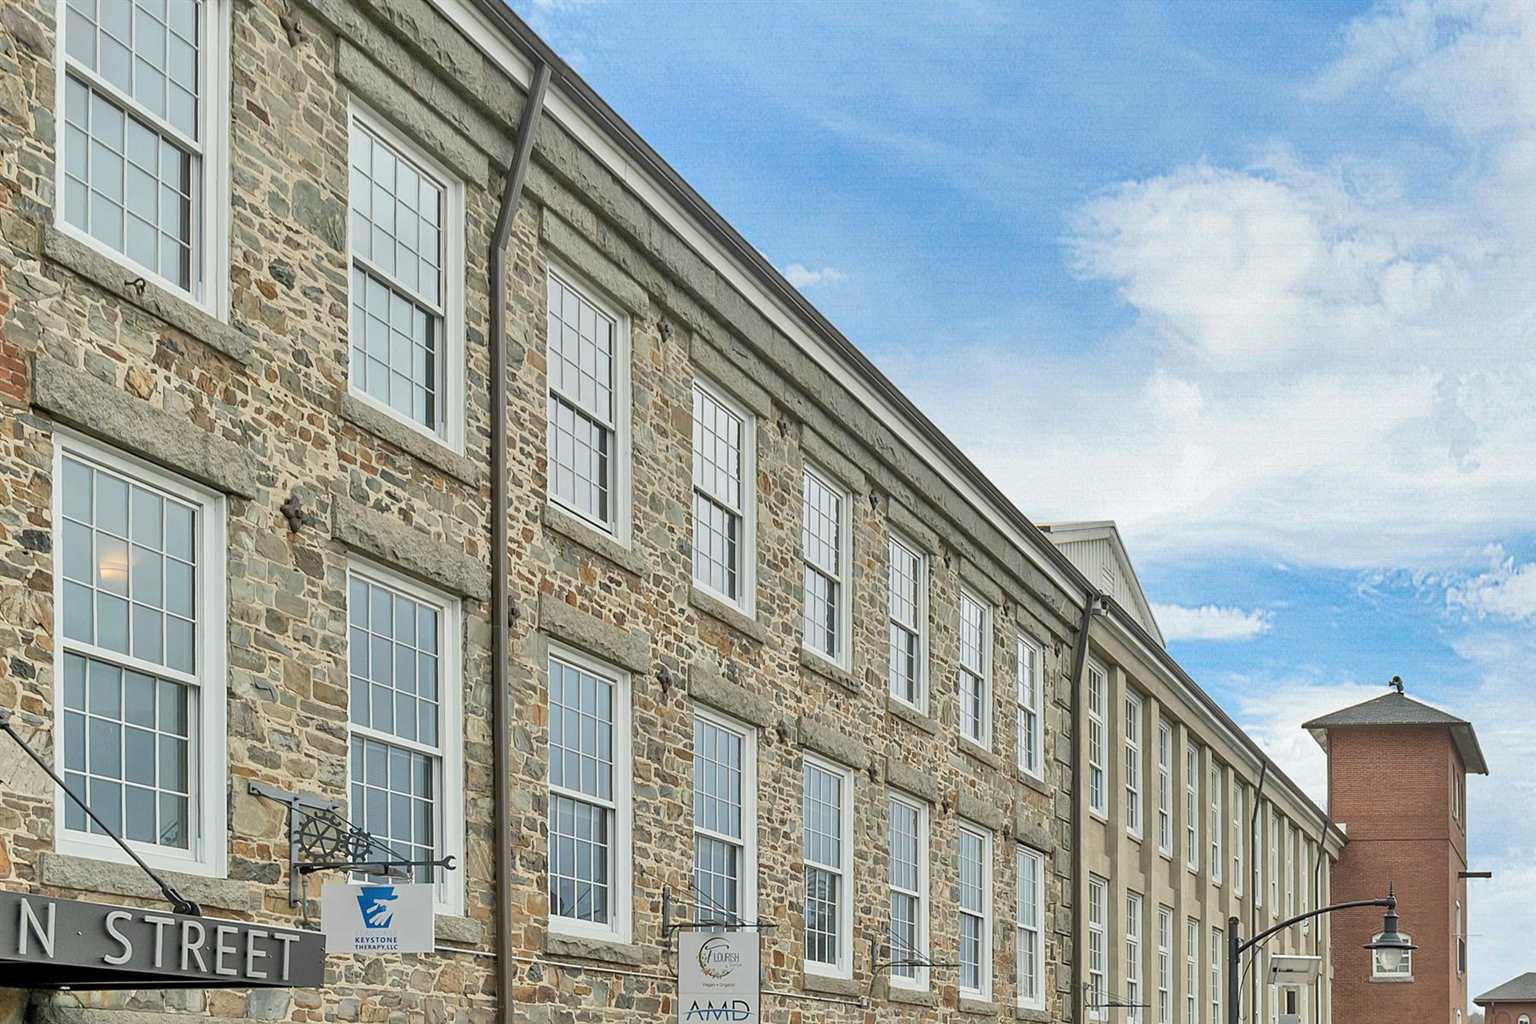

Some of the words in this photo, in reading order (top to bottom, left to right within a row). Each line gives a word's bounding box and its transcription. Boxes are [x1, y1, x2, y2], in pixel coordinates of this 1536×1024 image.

[18, 897, 56, 959] N
[103, 910, 301, 982] STREET
[354, 936, 398, 944] KEYSTONE
[686, 1000, 750, 1021] AMD
